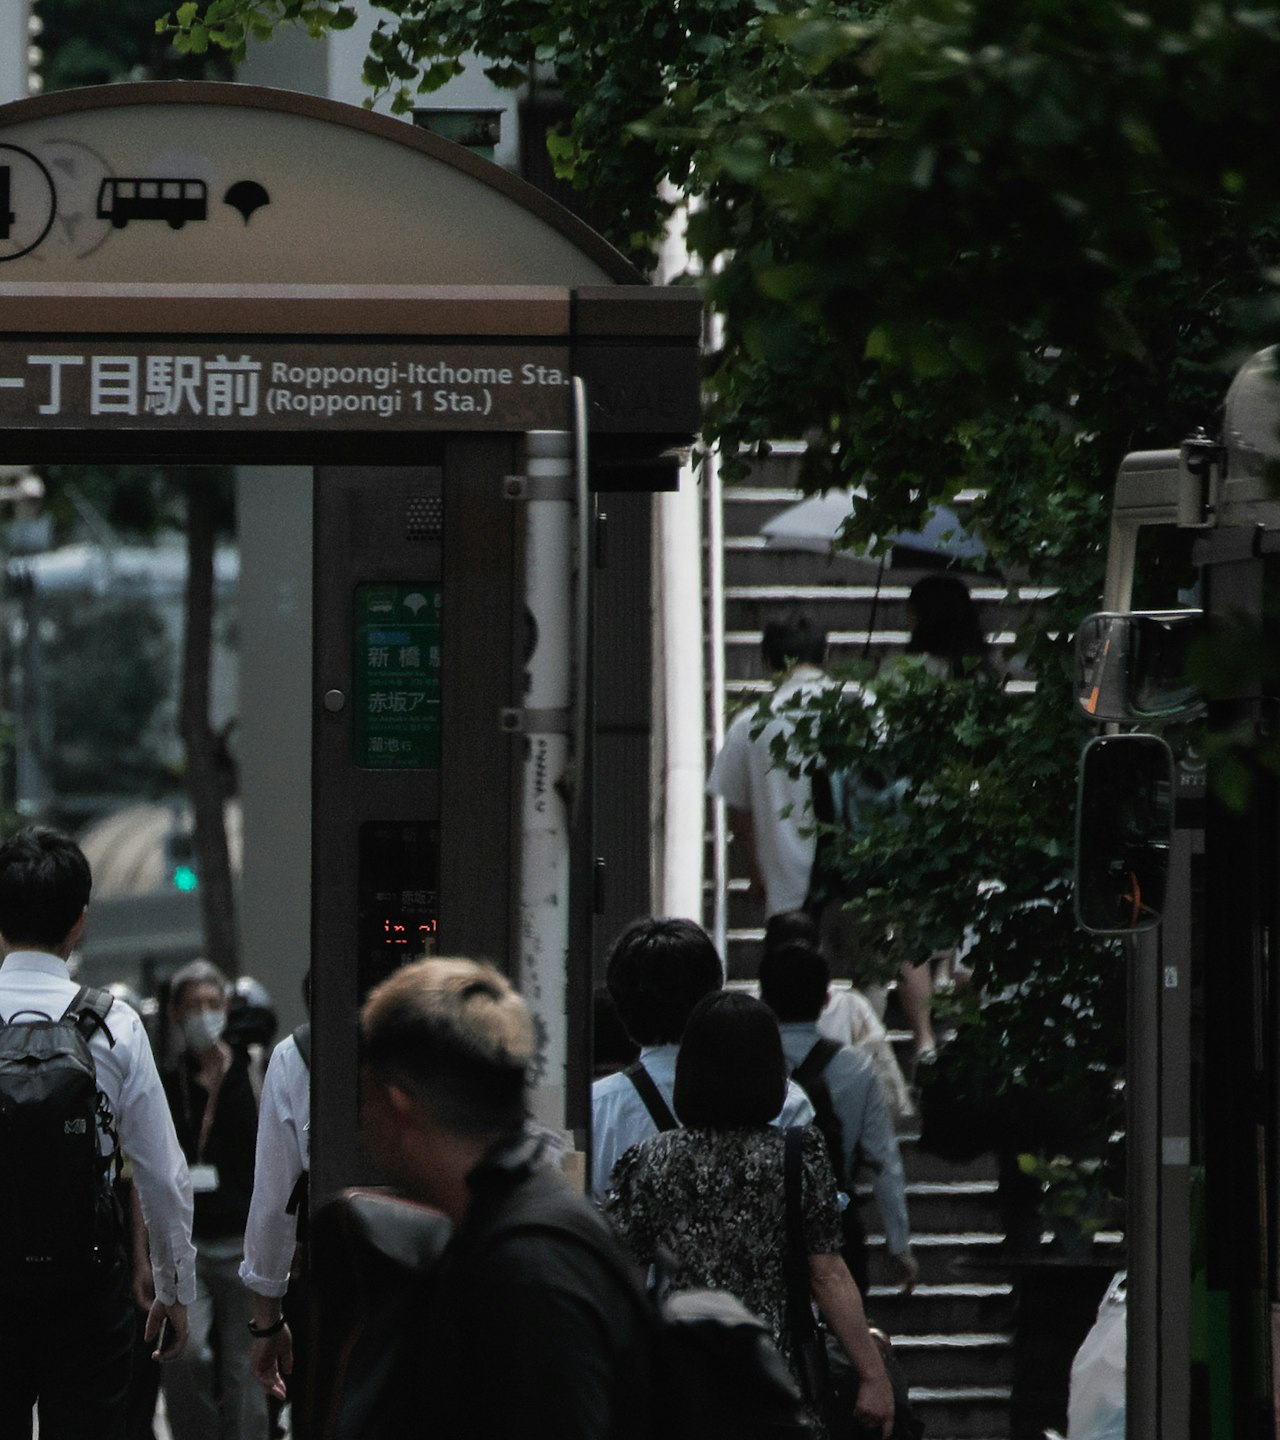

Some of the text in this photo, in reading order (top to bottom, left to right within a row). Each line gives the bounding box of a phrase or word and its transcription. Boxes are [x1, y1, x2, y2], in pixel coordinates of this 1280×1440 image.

[271, 362, 571, 389] Roppongi-Itchome Sta.
[265, 388, 493, 417] (Roppongi 1 Sta.)
